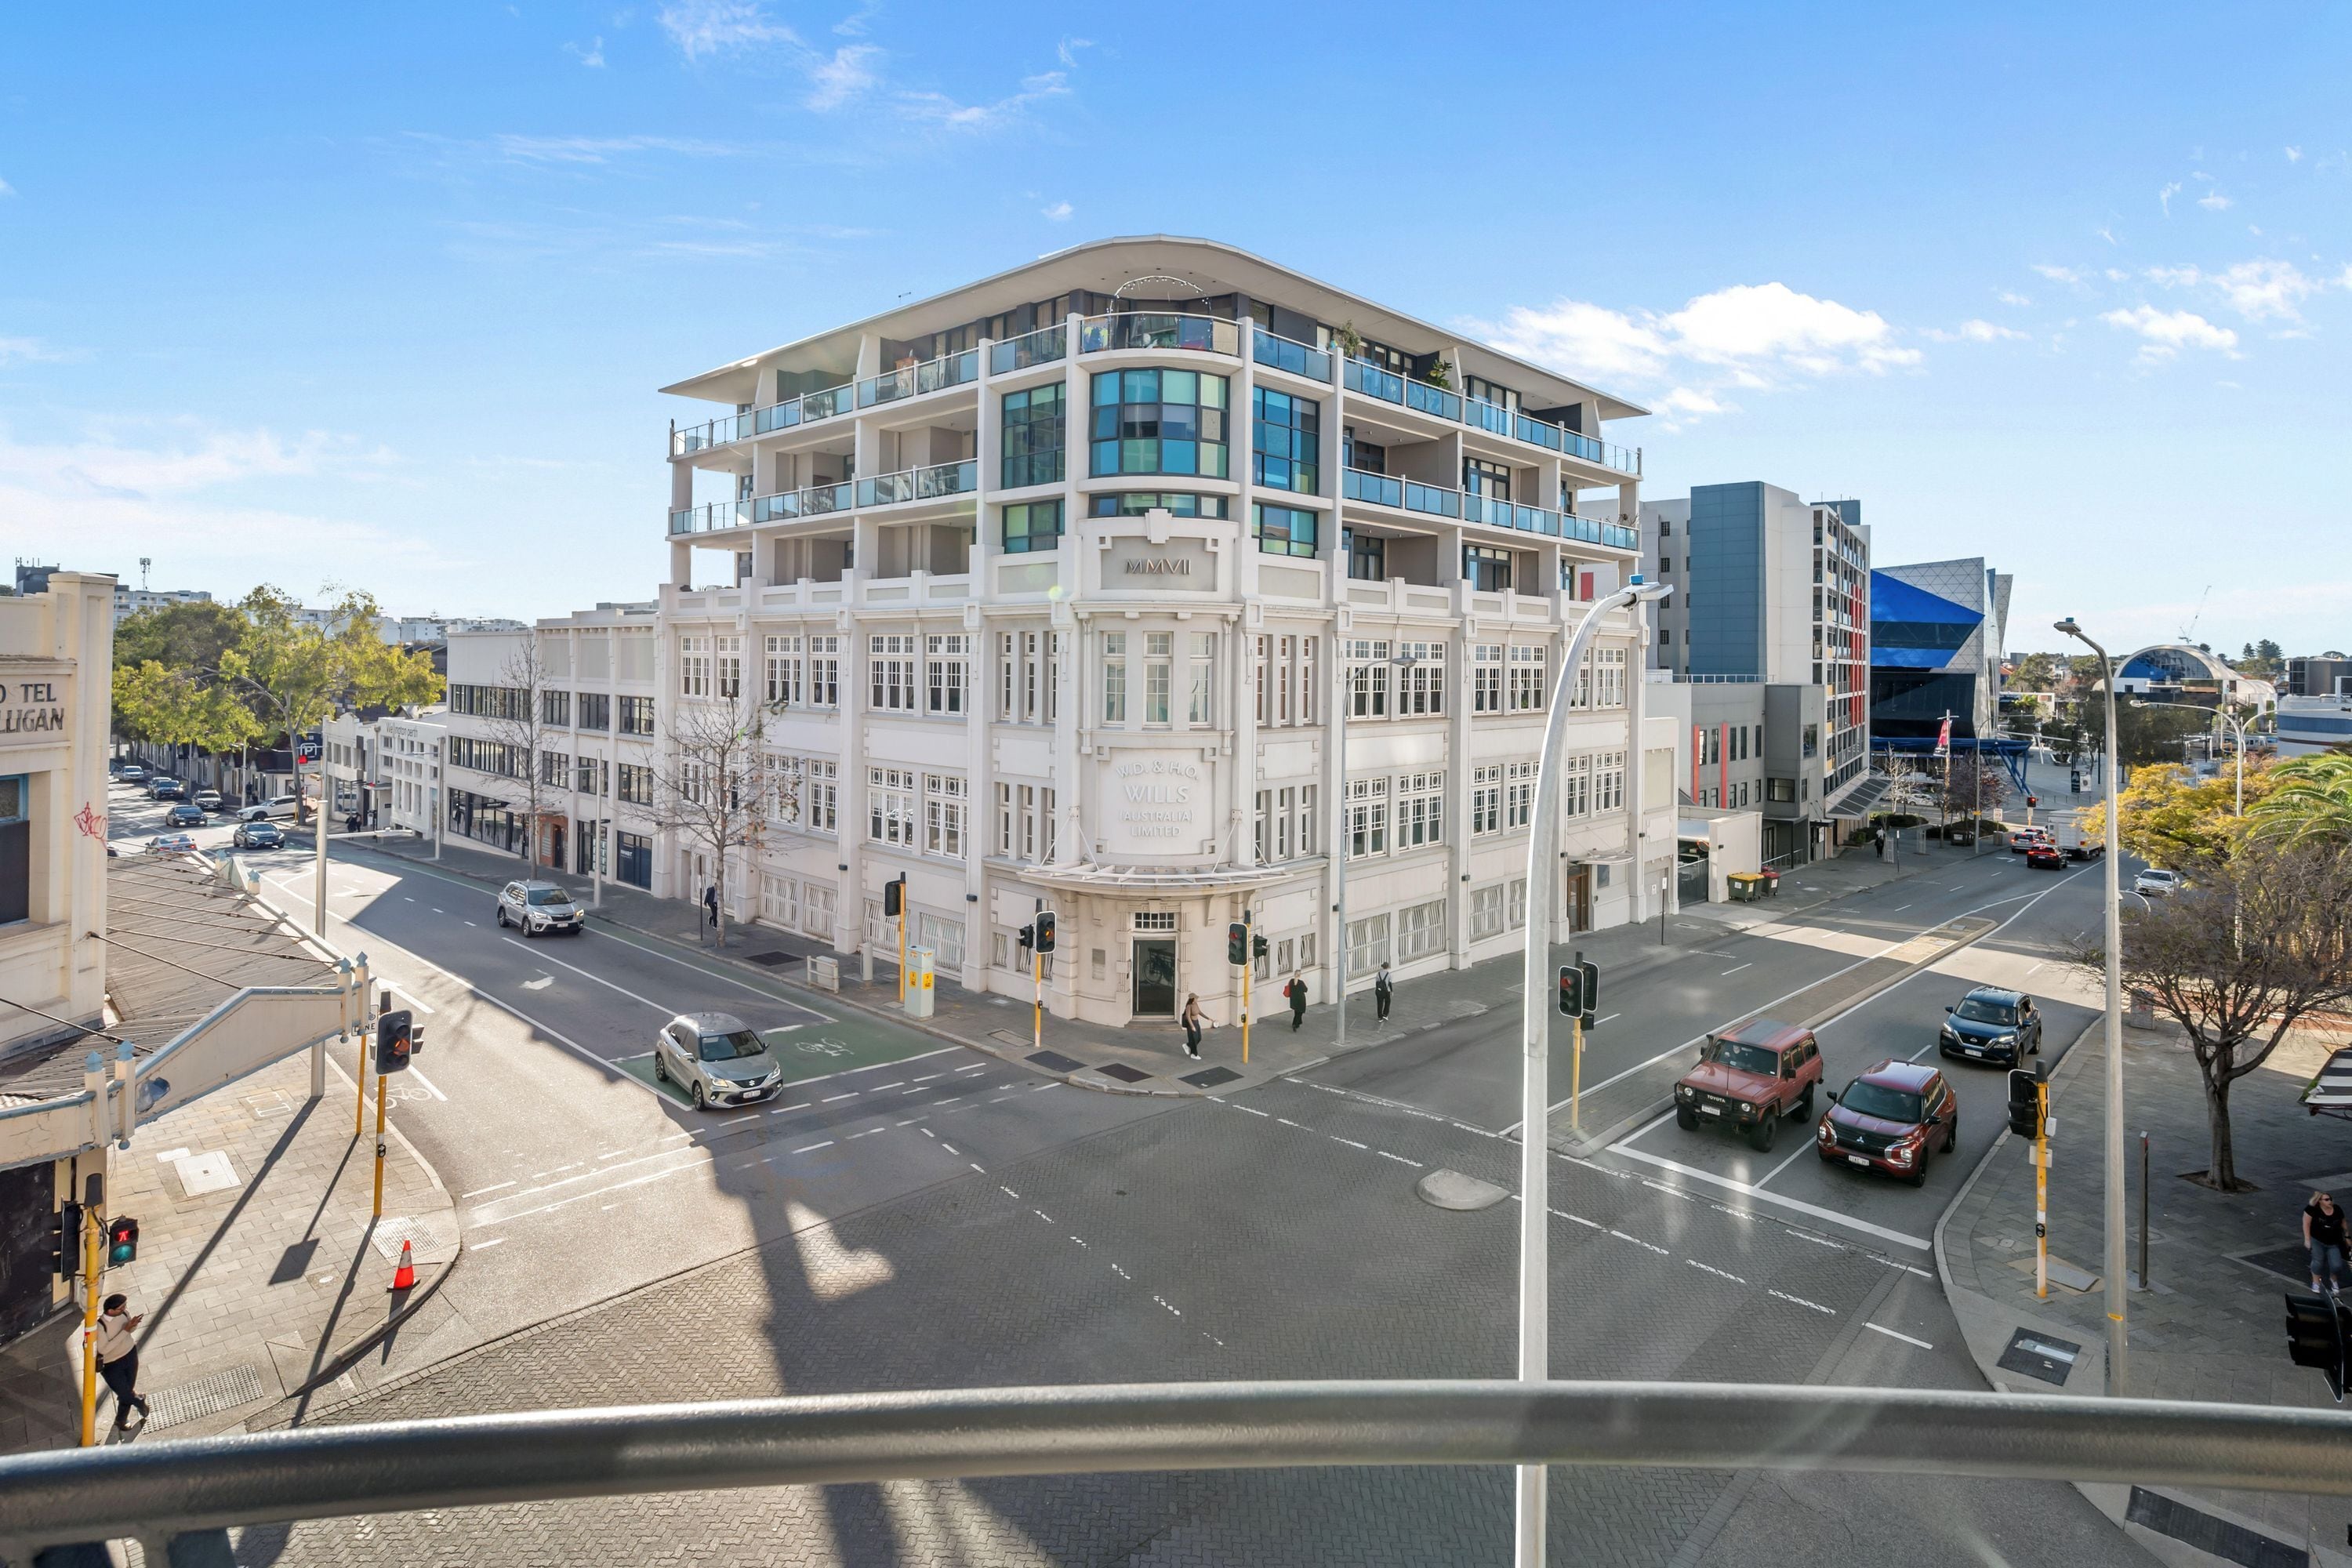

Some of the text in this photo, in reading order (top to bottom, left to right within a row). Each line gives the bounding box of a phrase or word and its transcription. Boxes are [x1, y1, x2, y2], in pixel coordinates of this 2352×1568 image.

[1125, 558, 1191, 575] MMVII
[1152, 759, 1166, 774] &
[1123, 785, 1191, 804] WILLS
[1119, 810, 1194, 824] (AUSTRALIA)
[1130, 826, 1181, 837] LIMITED
[354, 1022, 376, 1033] LNE
[1706, 1094, 1726, 1103] TOYOTA
